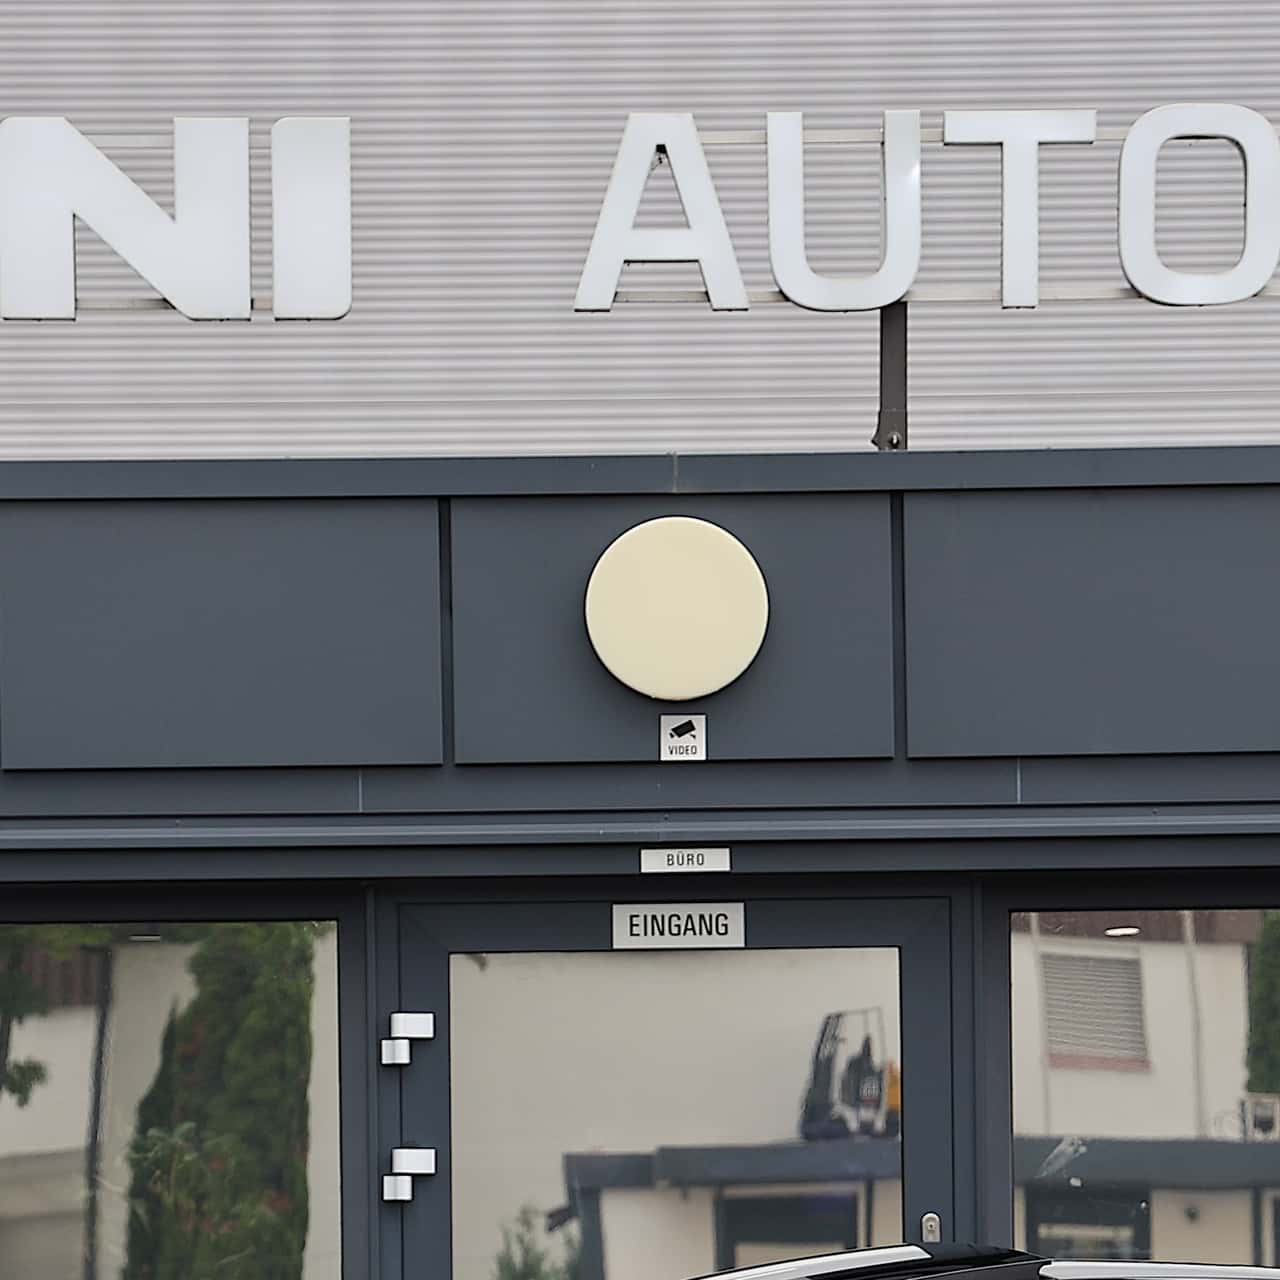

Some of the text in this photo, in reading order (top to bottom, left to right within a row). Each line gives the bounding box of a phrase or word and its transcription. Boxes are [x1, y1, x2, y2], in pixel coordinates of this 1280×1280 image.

[668, 745, 697, 755] VIDEO
[666, 852, 705, 866] BÜRO
[629, 913, 729, 937] EINGANG
